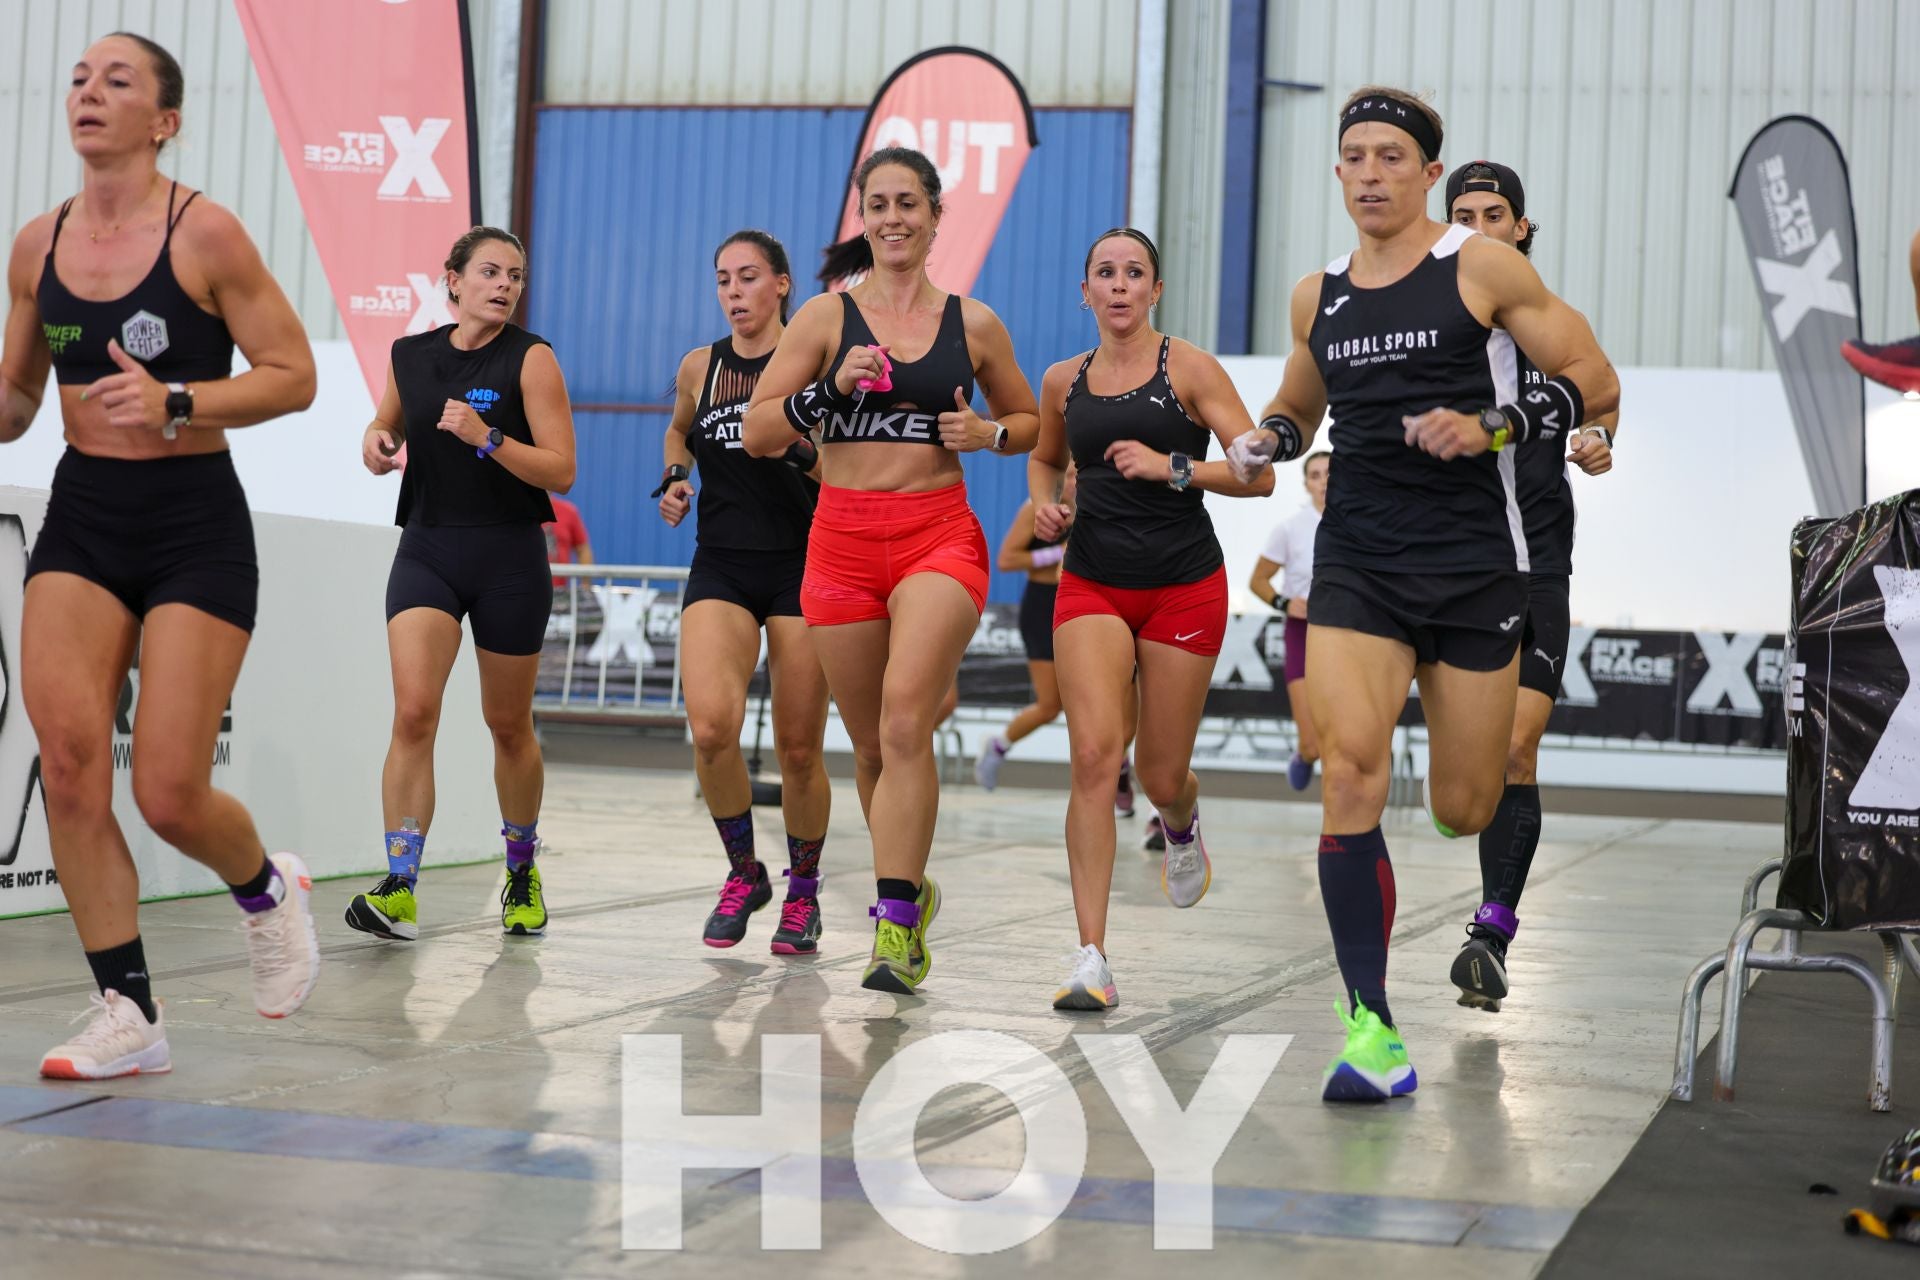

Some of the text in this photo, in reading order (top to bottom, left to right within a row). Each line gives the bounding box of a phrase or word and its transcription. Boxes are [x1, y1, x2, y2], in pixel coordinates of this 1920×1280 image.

[127, 320, 162, 340] POWER
[138, 337, 155, 355] FIT
[1327, 330, 1438, 361] GLOBAL SPORT
[1350, 353, 1407, 367] EQUIP YOUR TEAM
[471, 388, 494, 402] MB
[700, 406, 732, 428] WOLF
[829, 412, 936, 438] NIKE
[1592, 637, 1641, 657] FIT
[1590, 655, 1674, 678] RACE
[1847, 812, 1920, 828] YOU ARE
[17, 870, 43, 888] NOT
